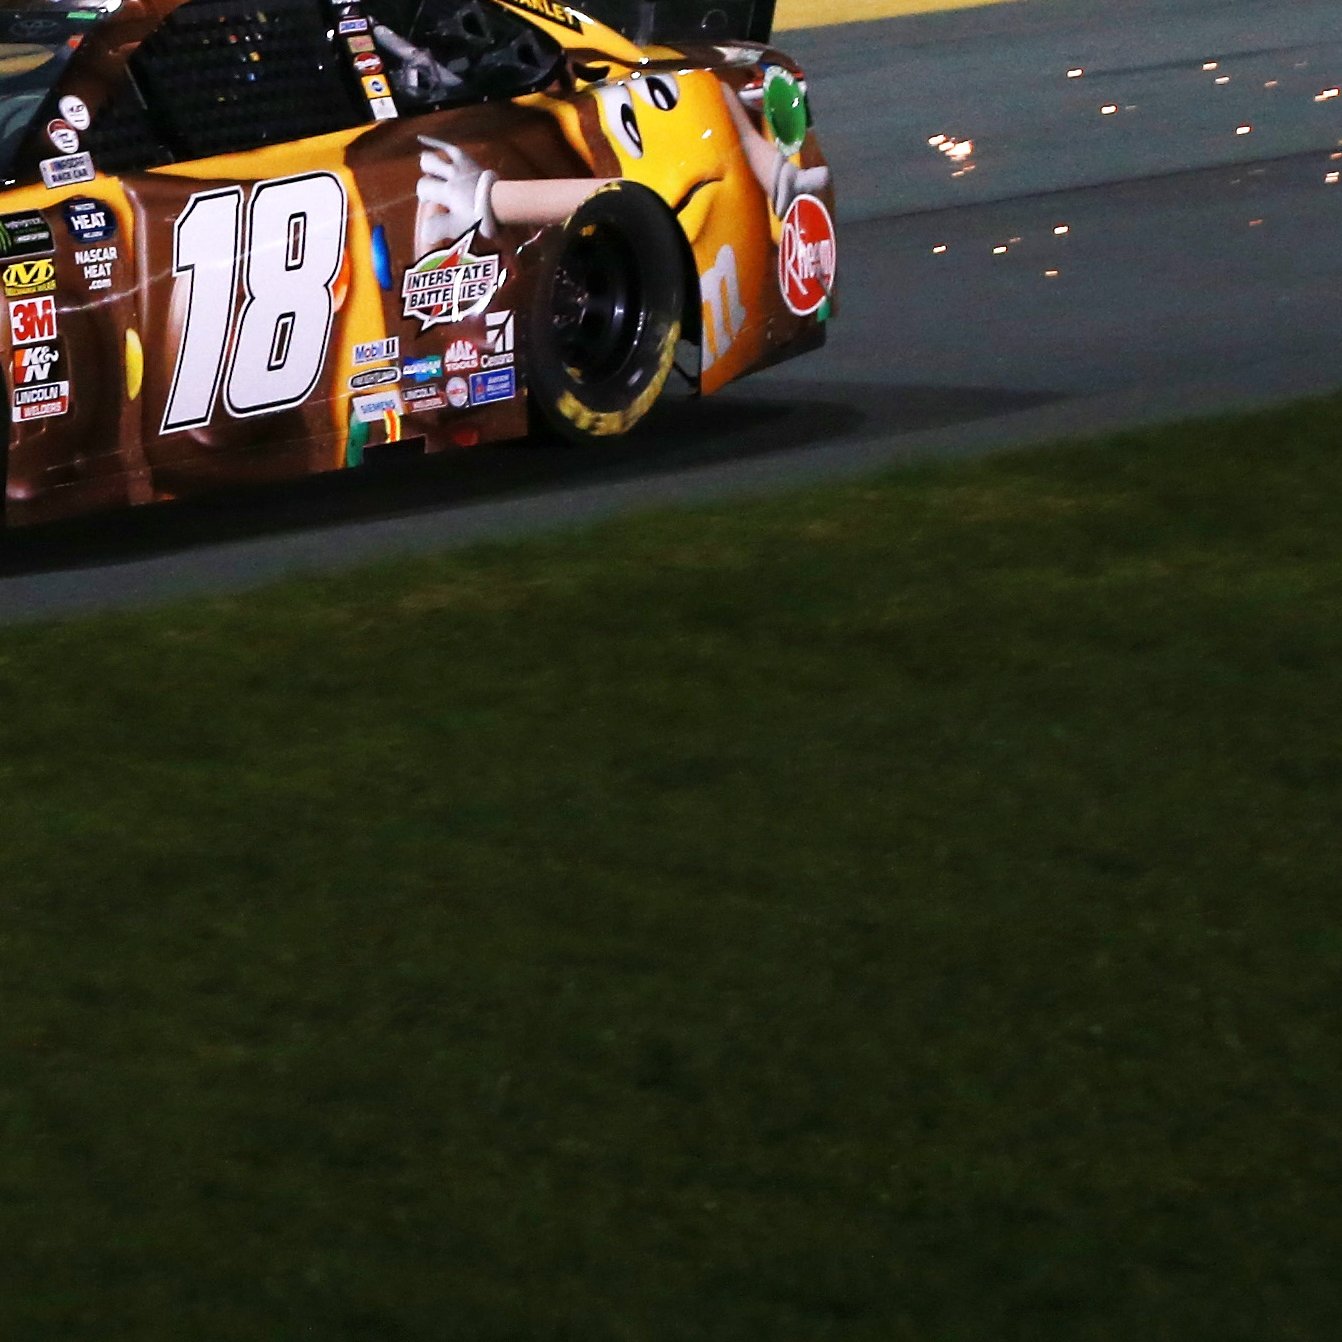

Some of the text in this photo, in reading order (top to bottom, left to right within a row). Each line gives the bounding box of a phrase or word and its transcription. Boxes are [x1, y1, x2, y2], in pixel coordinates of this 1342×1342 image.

[71, 211, 107, 231] HEAT
[74, 246, 118, 265] NASCAR
[83, 263, 113, 279] HEAT
[160, 170, 348, 435] 18
[409, 281, 487, 308] BATTEIES
[13, 299, 54, 340] 3M
[355, 341, 384, 360] Mobil
[445, 359, 479, 372] TOOLS
[15, 386, 58, 405] LINCOLN
[22, 401, 62, 417] WELDERS
